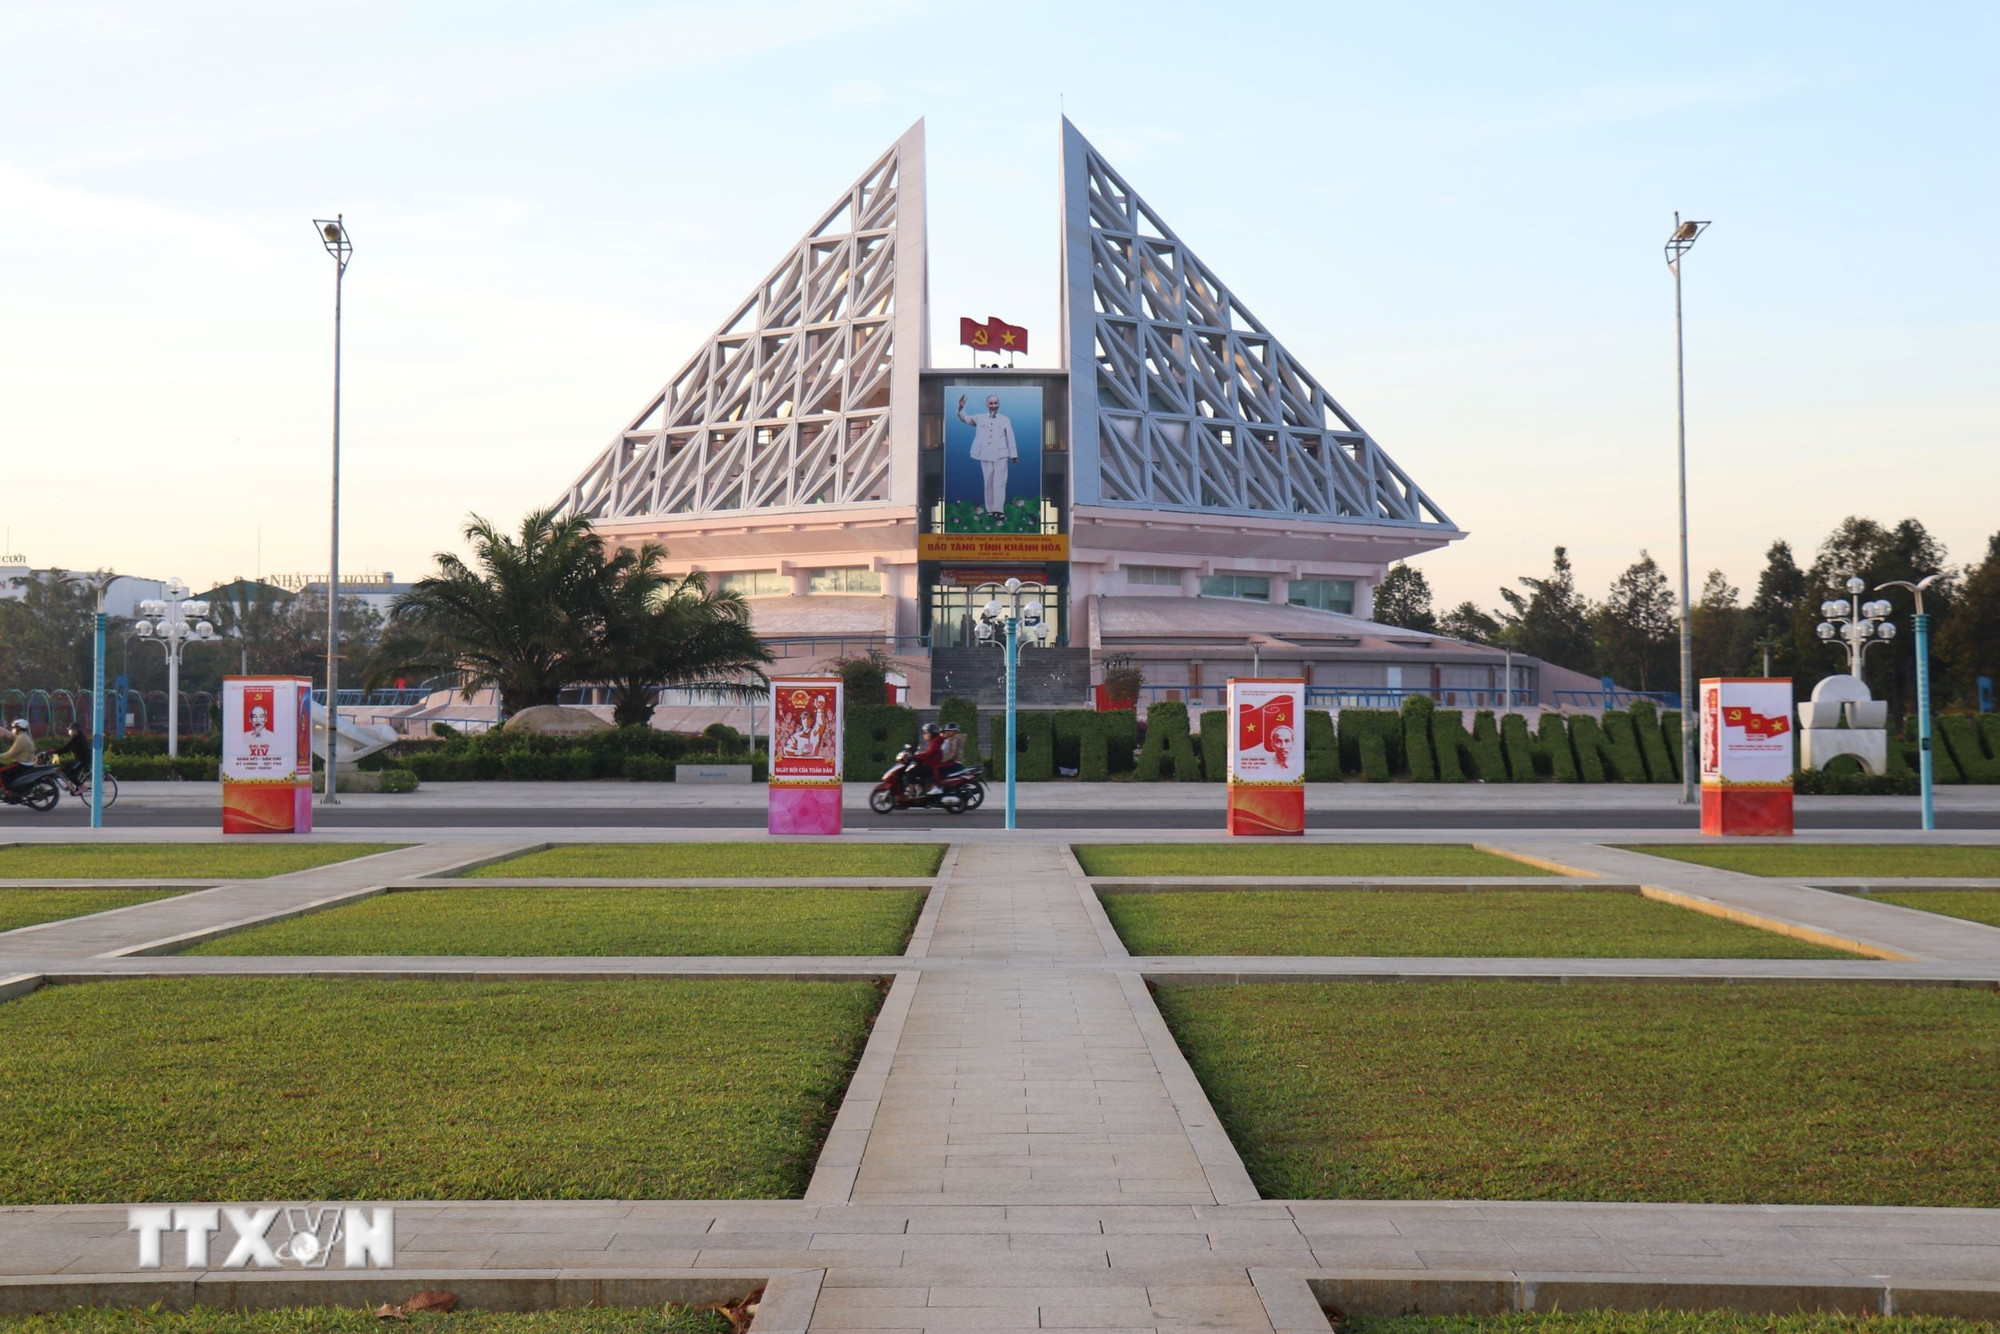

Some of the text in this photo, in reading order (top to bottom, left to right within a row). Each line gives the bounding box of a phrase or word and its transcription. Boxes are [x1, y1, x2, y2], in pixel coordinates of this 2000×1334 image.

[928, 542, 1062, 552] BẢO TÀNG TỈNH KHÁNH HÒA
[270, 571, 312, 589] NHẬT
